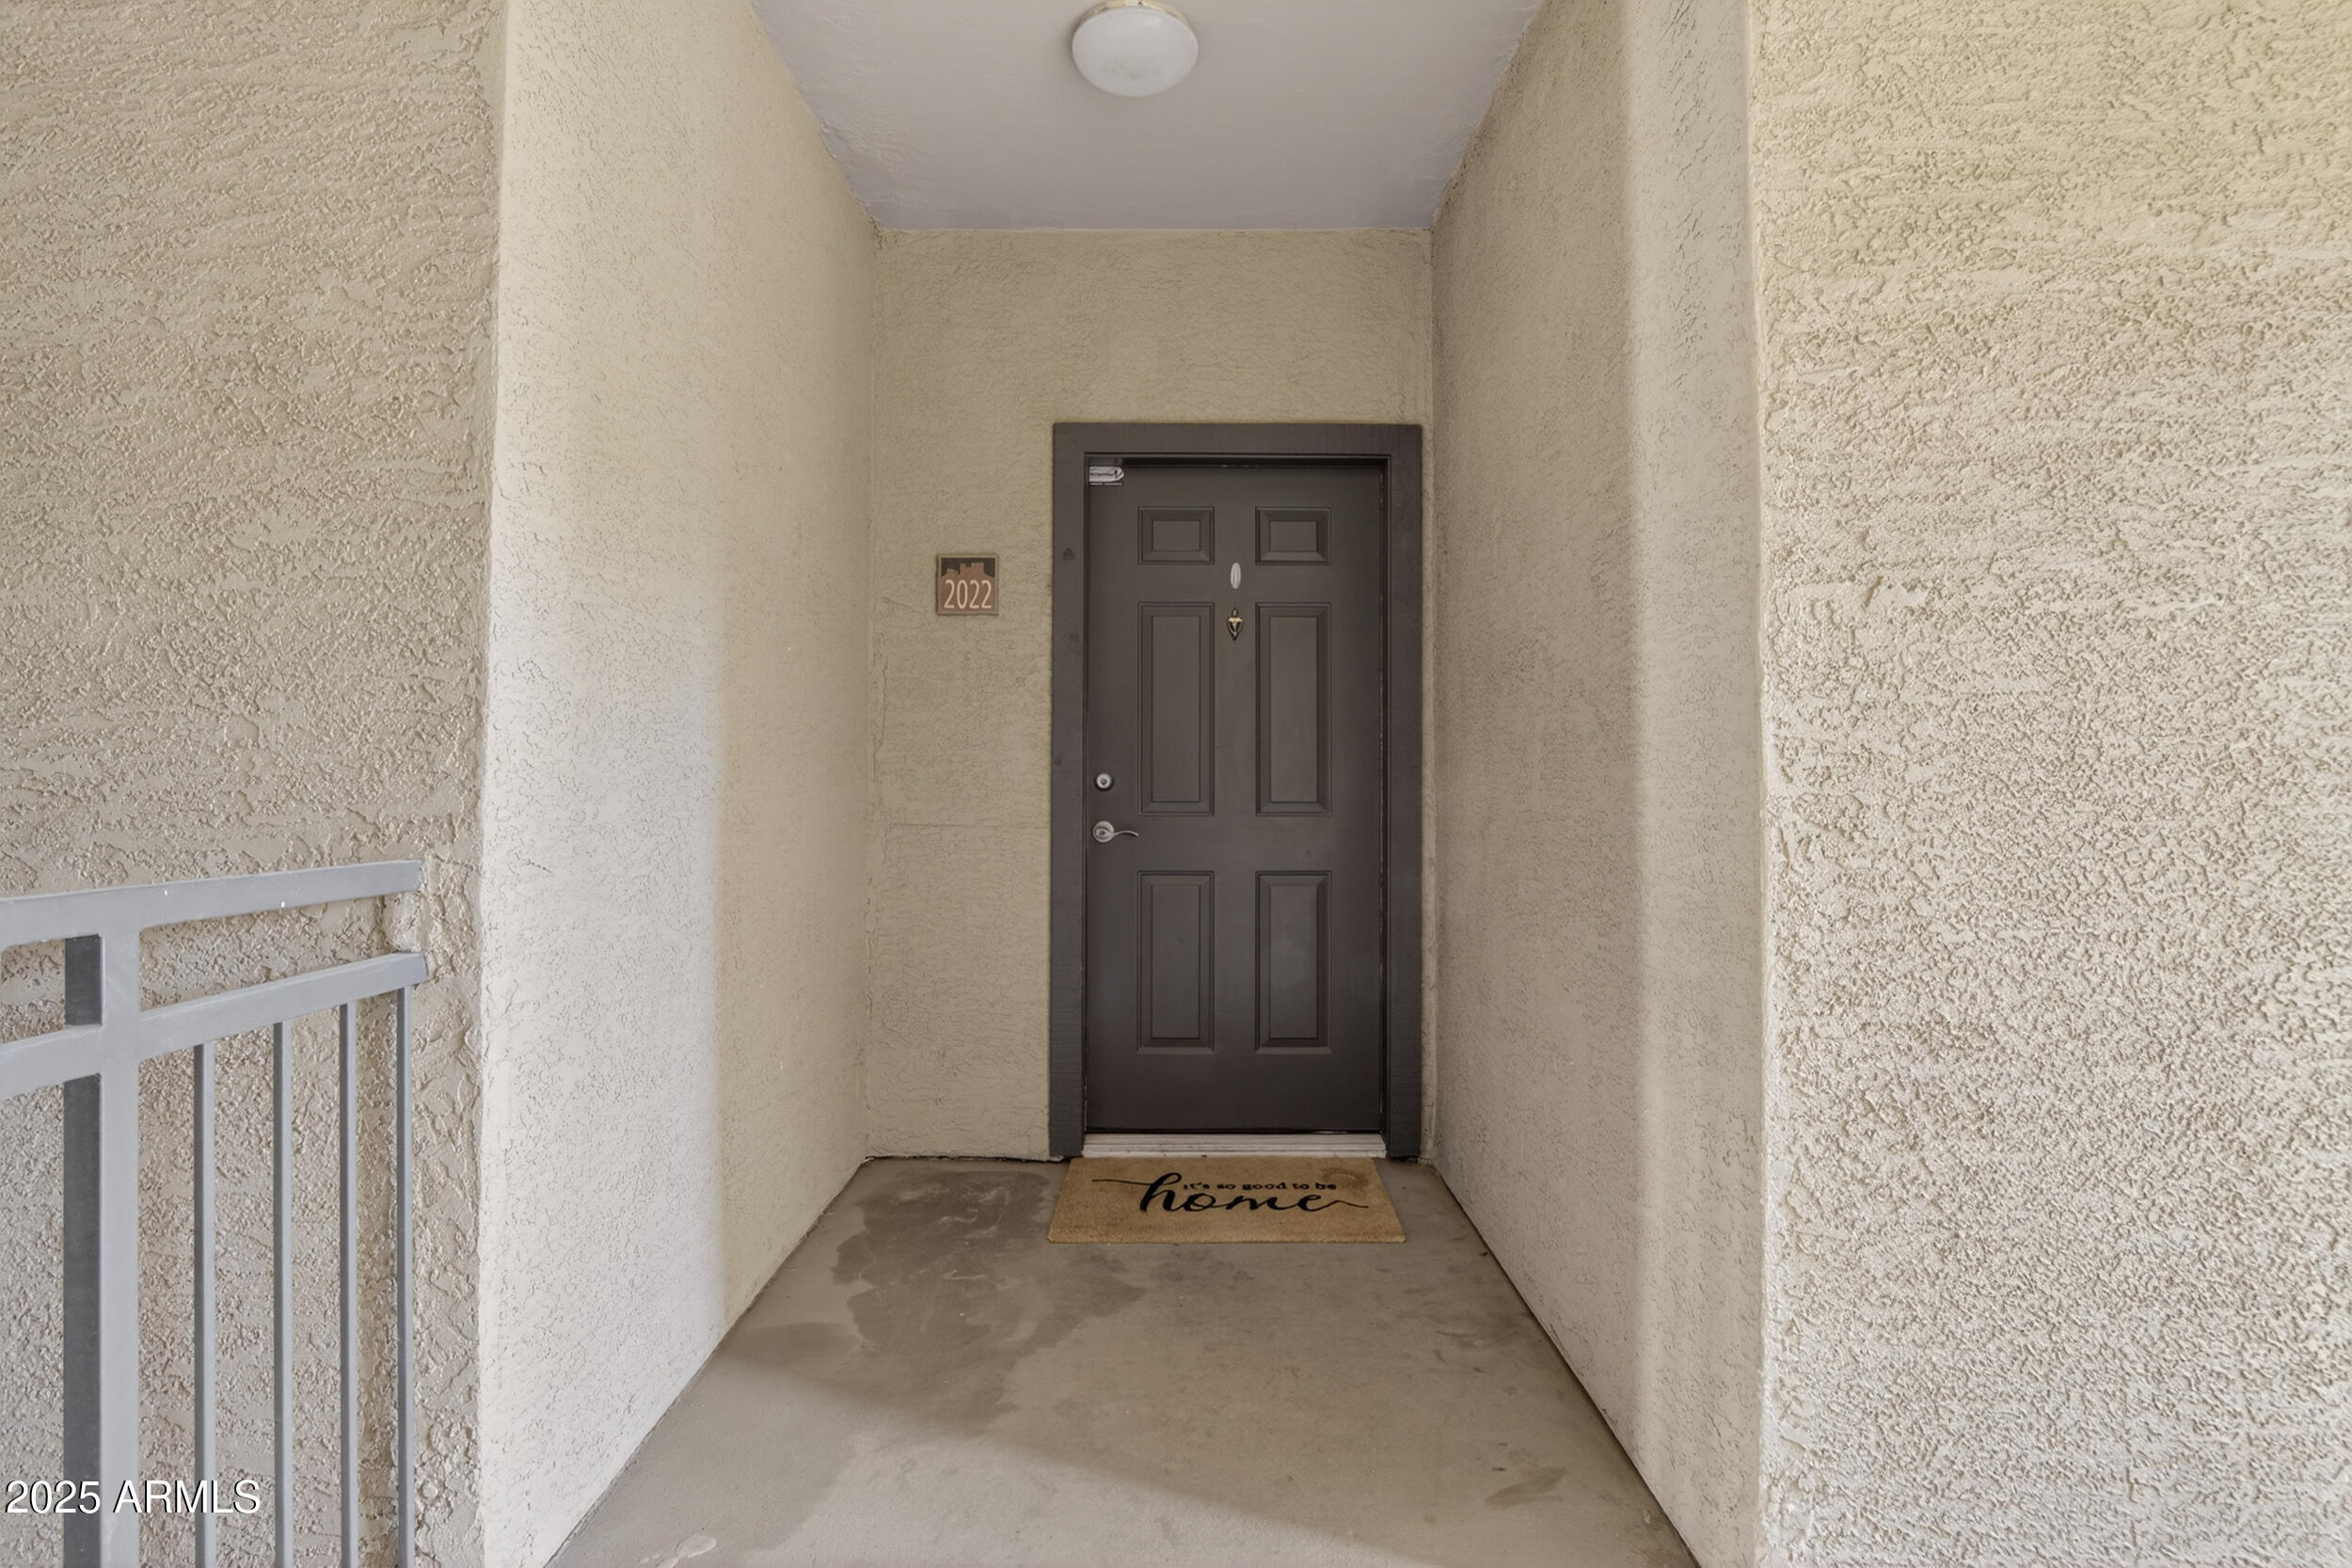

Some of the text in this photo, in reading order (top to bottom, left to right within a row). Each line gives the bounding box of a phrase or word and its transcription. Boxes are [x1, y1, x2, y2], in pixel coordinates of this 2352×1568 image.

[944, 579, 992, 610] 2022
[1091, 1172, 1369, 1212] home
[1217, 1181, 1235, 1190] so
[1242, 1181, 1287, 1191] good
[1293, 1181, 1309, 1190] to
[1315, 1181, 1337, 1190] be
